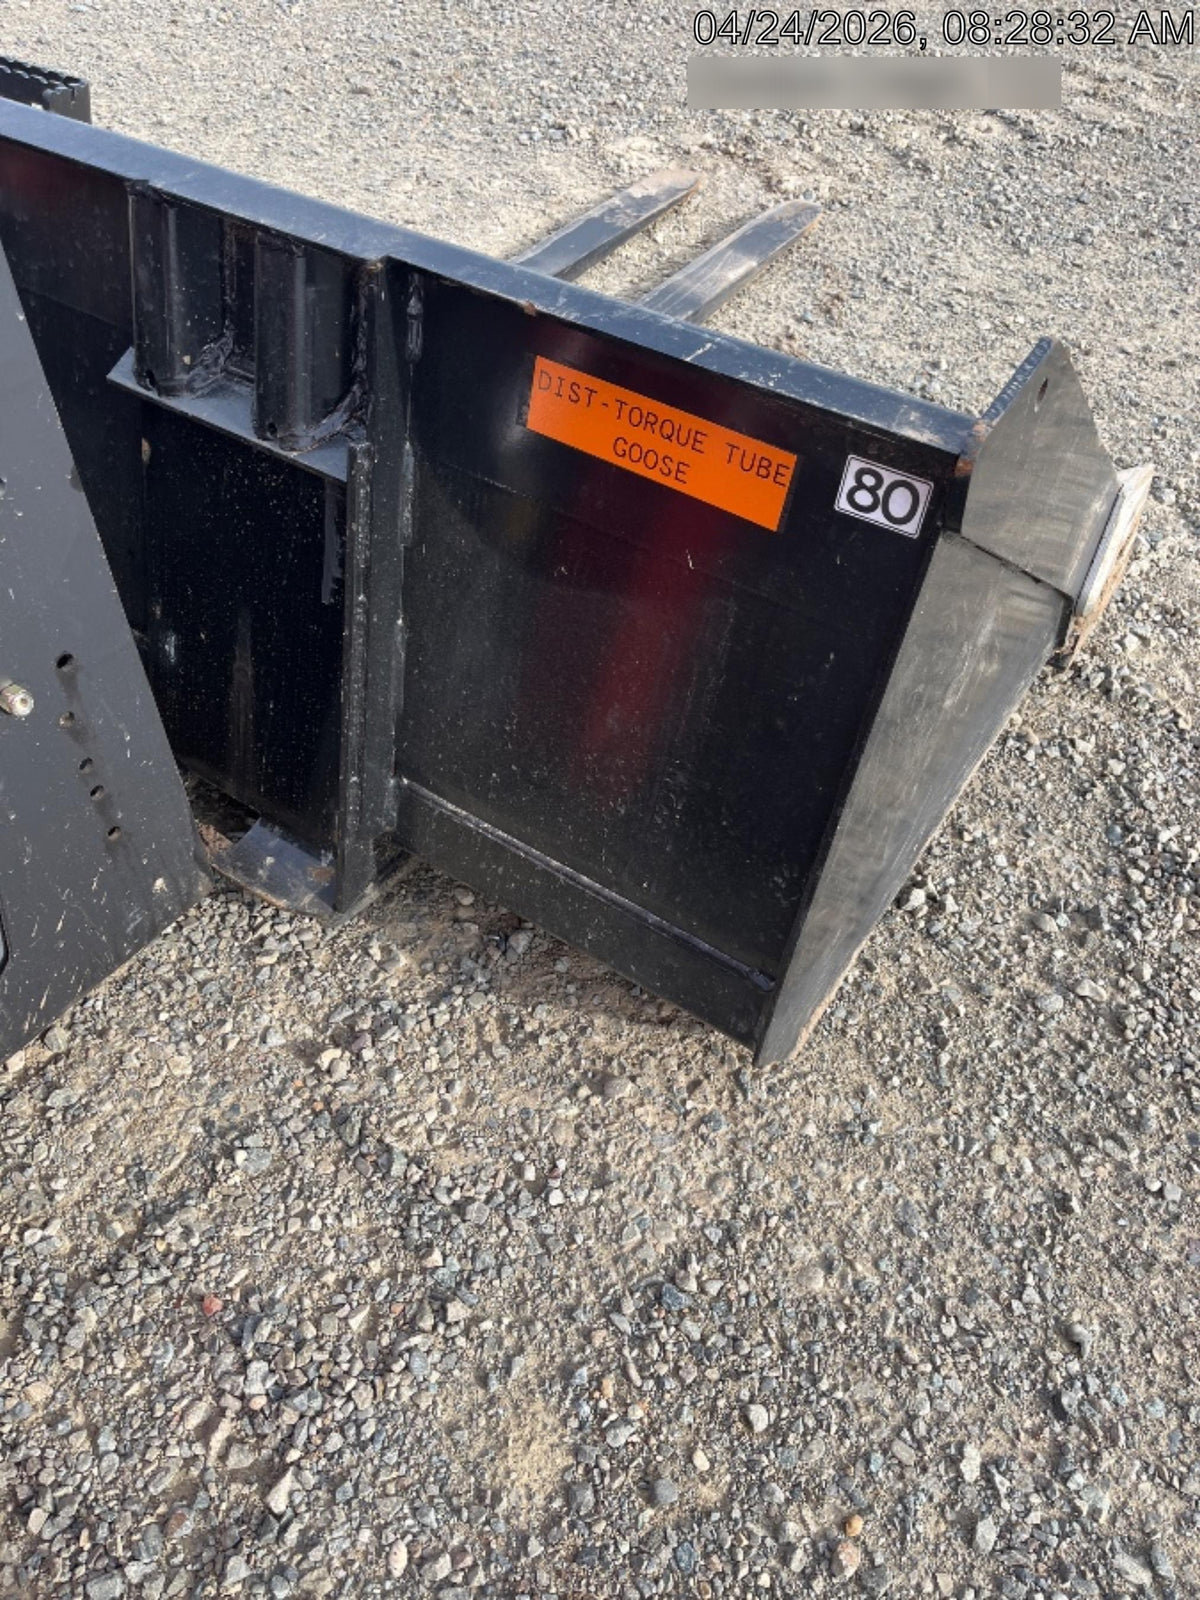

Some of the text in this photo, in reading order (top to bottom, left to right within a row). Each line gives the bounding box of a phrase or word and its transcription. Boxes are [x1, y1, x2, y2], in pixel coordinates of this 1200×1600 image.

[537, 370, 792, 487] DIST-TORQUE TUBE
[612, 436, 690, 485] GOOSE
[845, 467, 920, 526] 80
